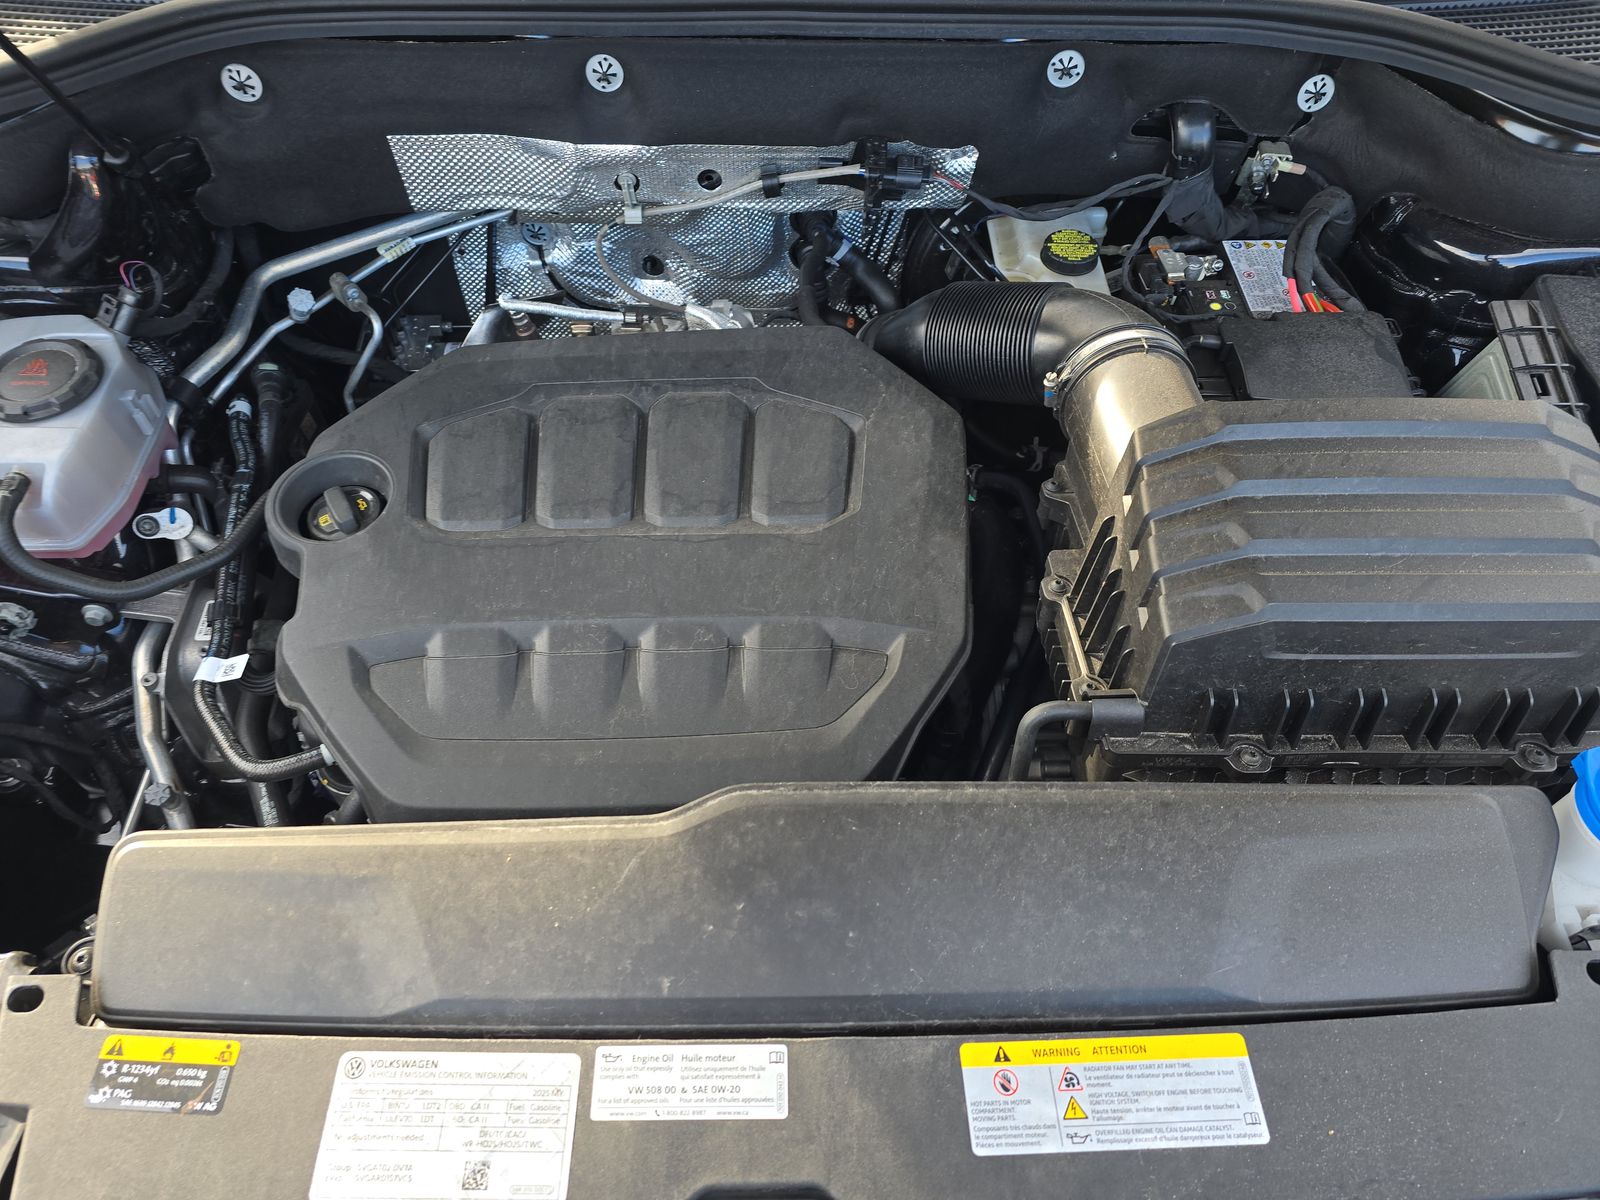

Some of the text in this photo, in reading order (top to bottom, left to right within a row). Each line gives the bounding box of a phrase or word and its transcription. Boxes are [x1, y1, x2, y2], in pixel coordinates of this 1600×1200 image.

[1032, 1044, 1147, 1058] WARNING ATTENTION
[632, 1054, 673, 1064] Engine Oil
[681, 1054, 702, 1062] Huile
[370, 1059, 439, 1069] VOLKSWAGEN
[438, 1071, 472, 1079] CONTROL
[475, 1071, 528, 1080] INFORMATION
[113, 1088, 133, 1098] PAG
[628, 1085, 643, 1094] VW
[646, 1085, 662, 1094] 508
[664, 1085, 676, 1094] 00
[692, 1085, 708, 1094] SAE
[711, 1085, 741, 1094] 0W-20
[1010, 1098, 1031, 1106] MOTOR
[530, 1103, 562, 1111] Gasoline
